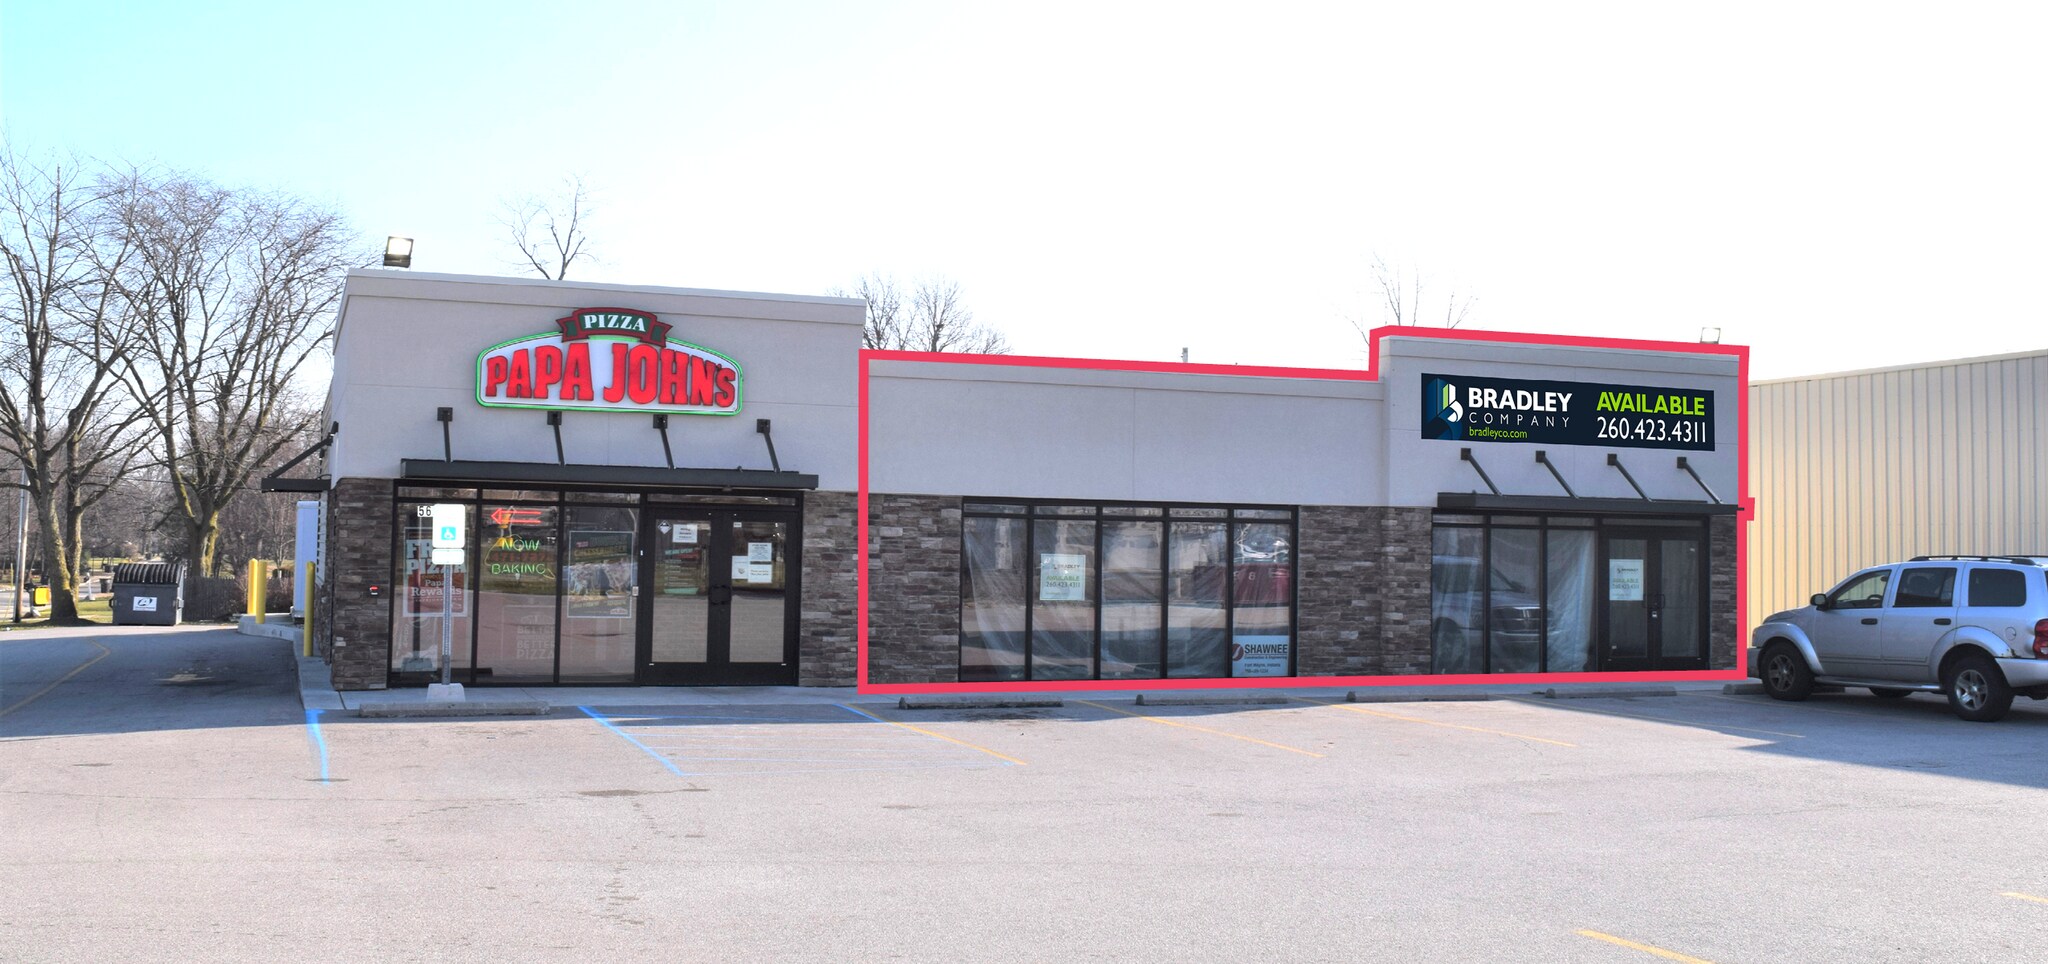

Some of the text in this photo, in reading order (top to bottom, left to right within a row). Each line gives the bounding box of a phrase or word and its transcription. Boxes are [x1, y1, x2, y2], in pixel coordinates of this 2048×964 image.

[583, 314, 647, 333] PIZZA
[485, 342, 736, 408] PAPA JOHN'S
[1468, 387, 1573, 412] BRADLEY
[1597, 391, 1705, 416] AVAILABLE
[1469, 412, 1570, 428] COMPANY
[1469, 426, 1528, 440] bradleyco.com
[1597, 416, 1706, 443] 260.423.4311
[502, 540, 540, 552] NOW
[491, 563, 546, 575] BAKING
[411, 586, 462, 597] Rewads
[1244, 644, 1288, 653] SHAWNEE
